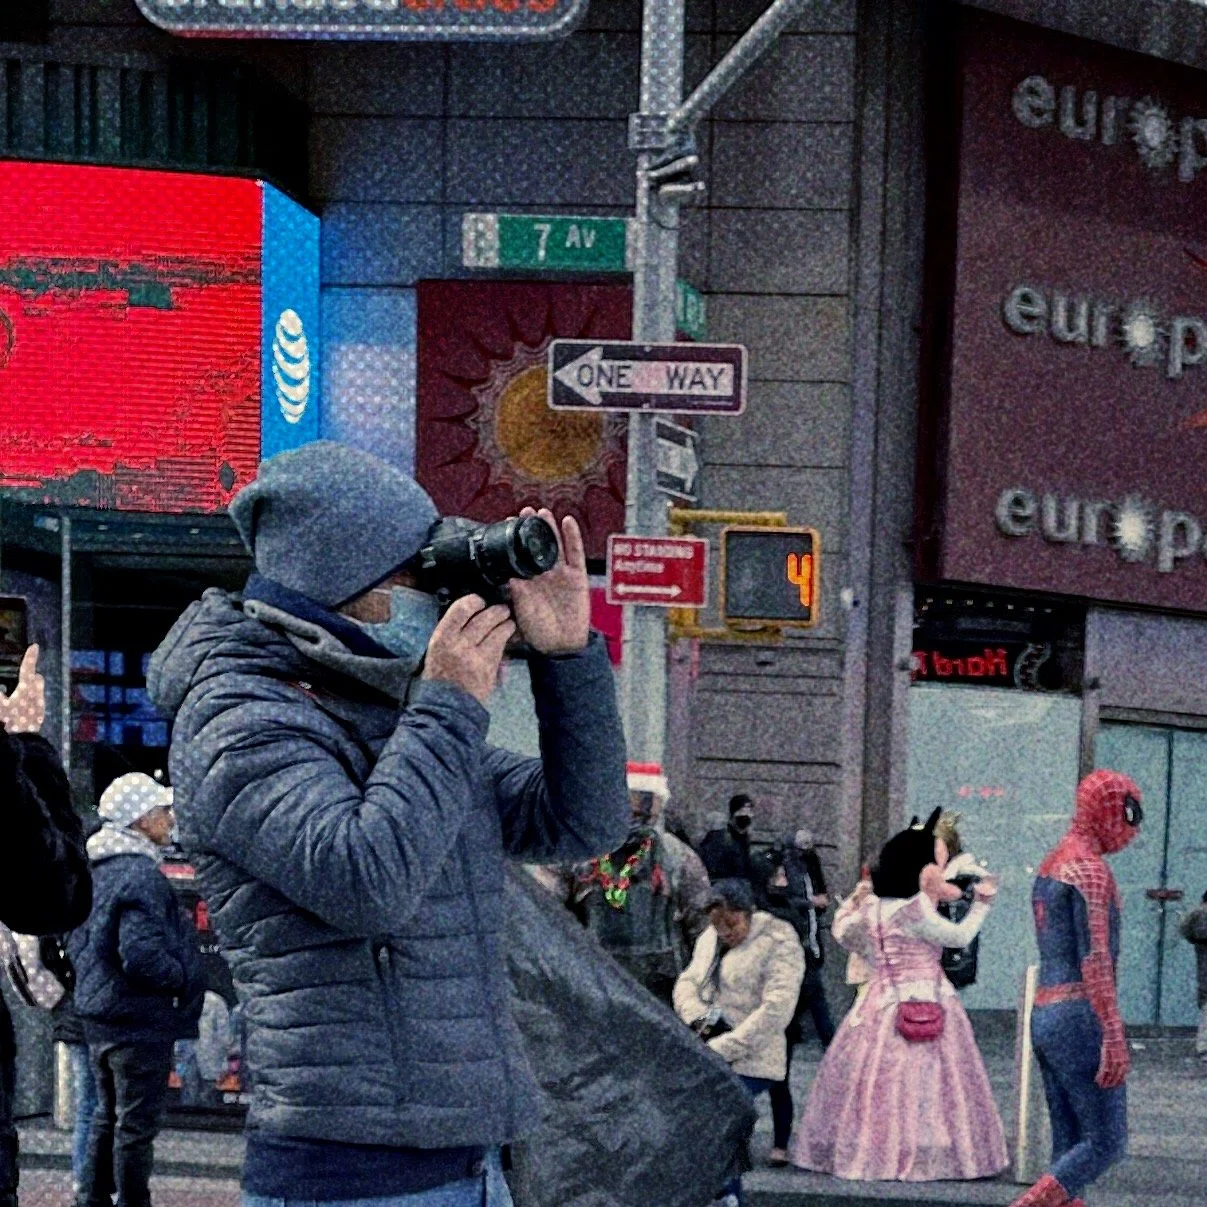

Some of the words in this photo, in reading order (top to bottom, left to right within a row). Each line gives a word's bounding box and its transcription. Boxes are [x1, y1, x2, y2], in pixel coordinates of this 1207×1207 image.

[533, 223, 550, 261] 7
[565, 224, 597, 249] AV
[575, 363, 633, 389] ONE
[665, 366, 726, 391] WAY
[786, 552, 813, 607] 4
